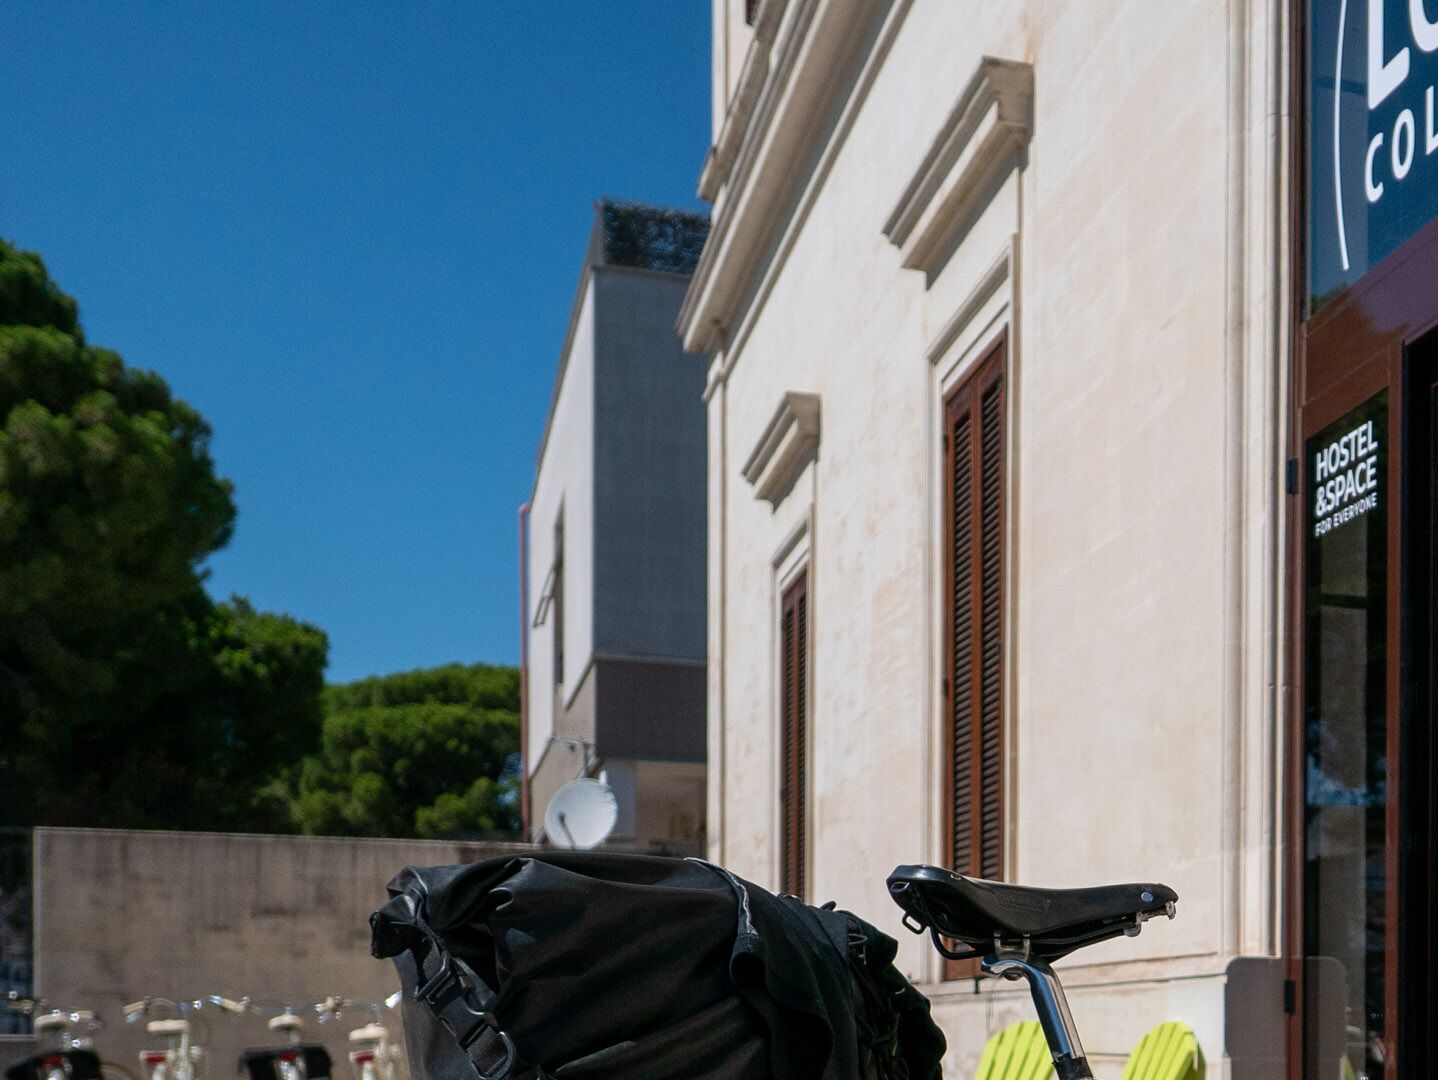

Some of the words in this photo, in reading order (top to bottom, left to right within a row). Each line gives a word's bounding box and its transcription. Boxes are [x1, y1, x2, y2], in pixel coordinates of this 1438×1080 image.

[1316, 420, 1379, 482] HOSTEL
[1315, 455, 1377, 517] &SPACE
[1315, 517, 1333, 538] FOR
[1333, 491, 1378, 528] EVERYONE
